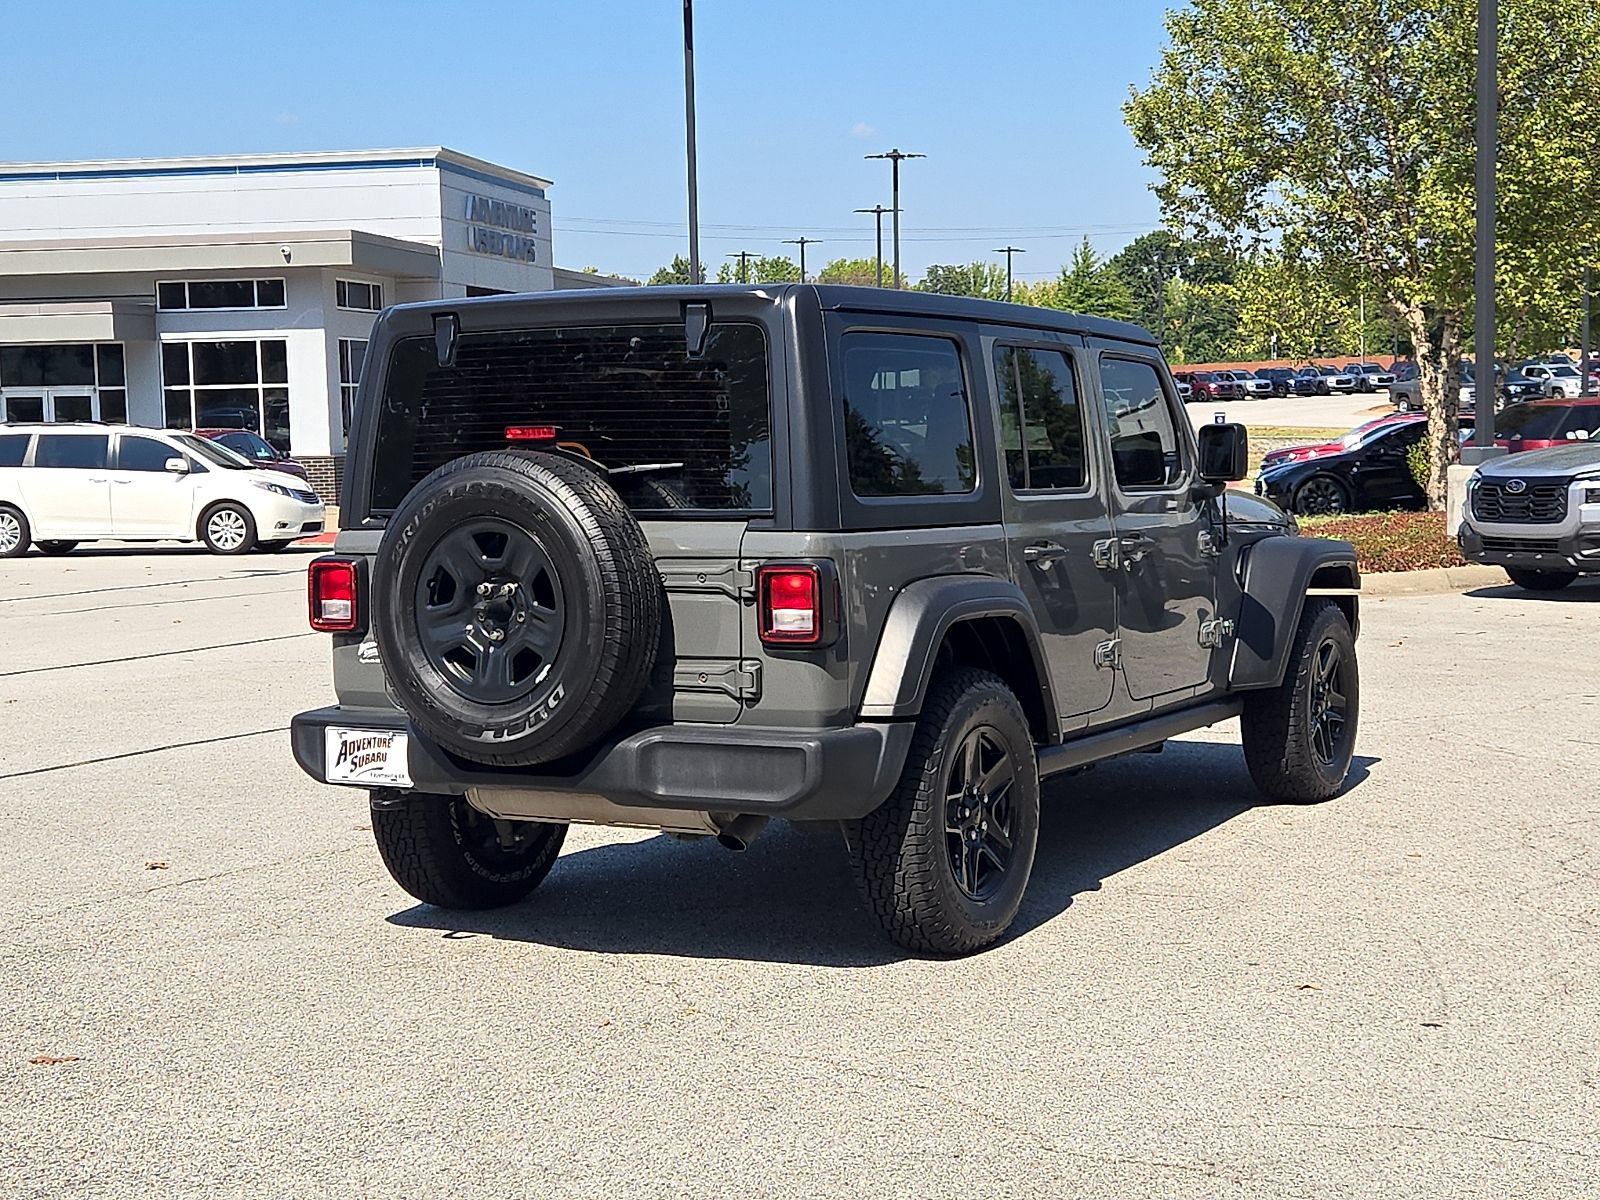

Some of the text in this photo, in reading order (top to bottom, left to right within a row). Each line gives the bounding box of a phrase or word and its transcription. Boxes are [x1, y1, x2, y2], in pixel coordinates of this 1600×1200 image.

[465, 194, 537, 234] ADVENTURE
[335, 736, 391, 768] ADVENTURE
[349, 752, 388, 773] SUBARU
